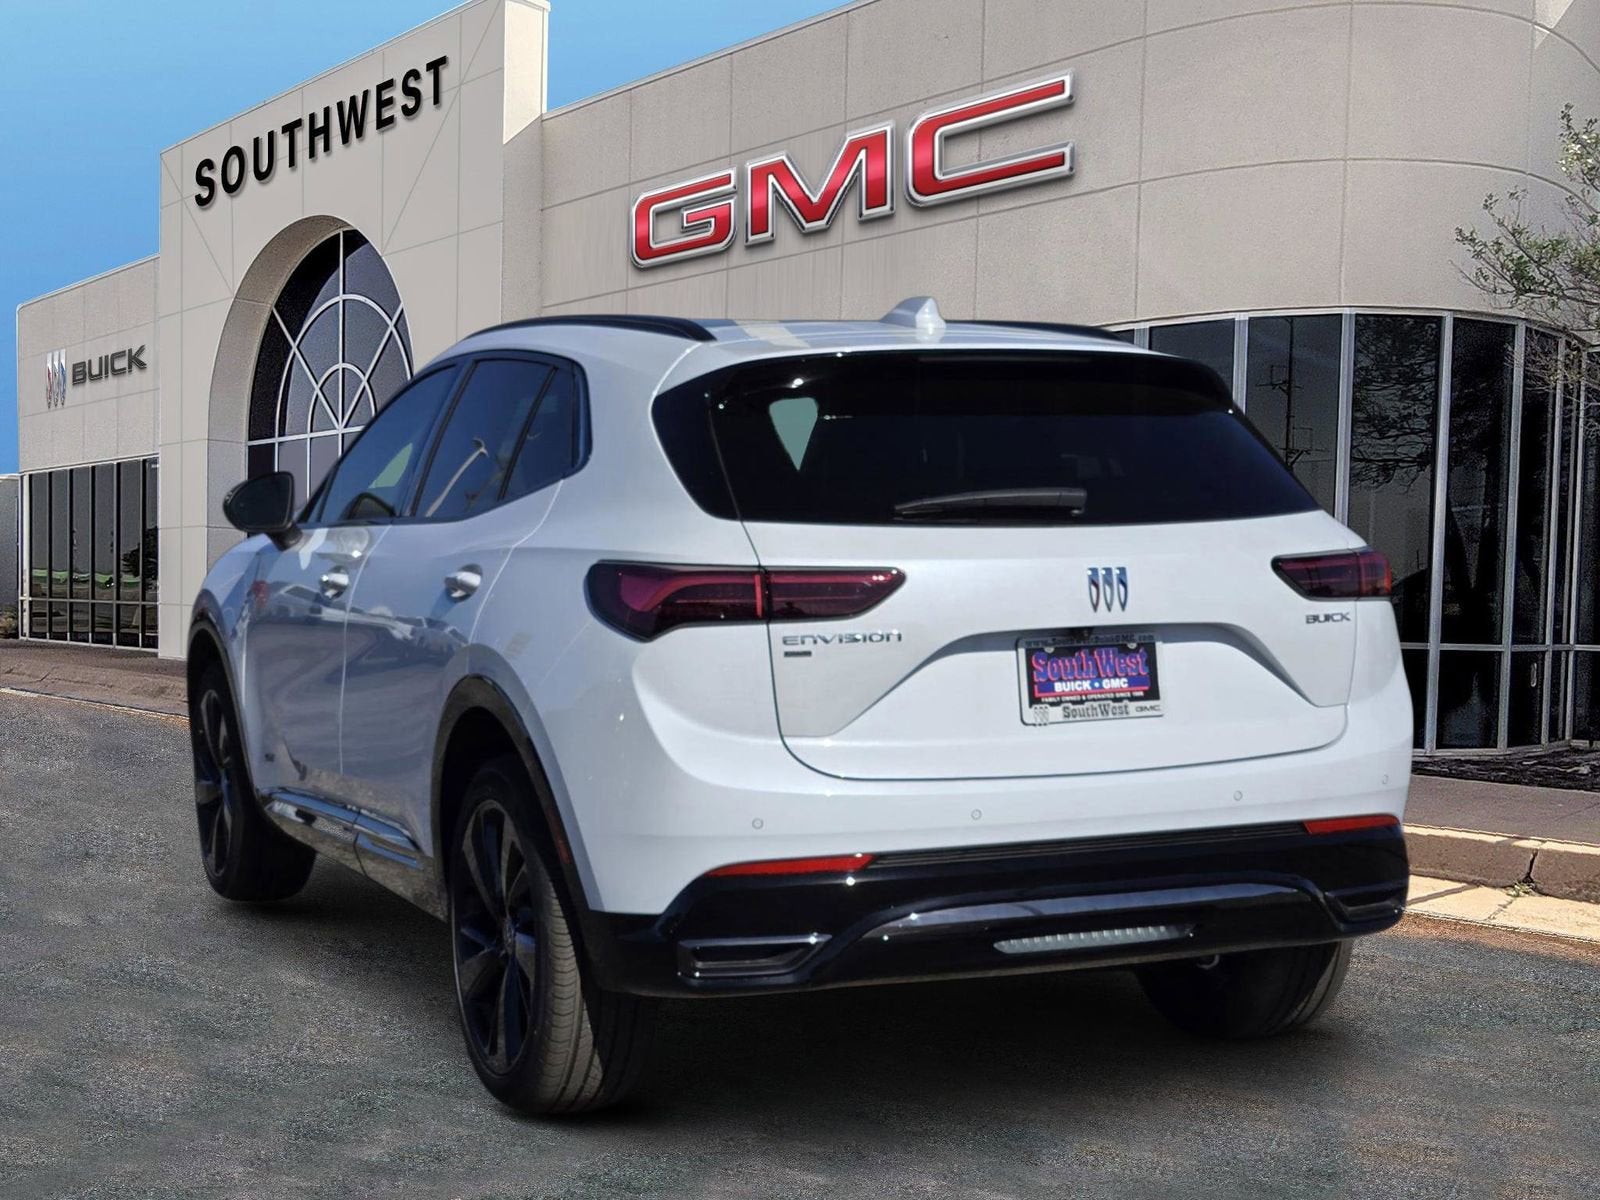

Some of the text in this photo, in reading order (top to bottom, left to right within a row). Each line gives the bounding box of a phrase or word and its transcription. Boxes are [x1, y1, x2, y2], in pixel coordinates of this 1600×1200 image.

[194, 56, 448, 207] SOUTHWEST
[631, 69, 1075, 268] GMC
[72, 344, 147, 386] BUICK
[1305, 612, 1351, 624] BUICK
[782, 631, 902, 645] ENVISION
[1031, 647, 1149, 682] SouthWest
[1054, 678, 1129, 692] BUICK GMC
[1062, 703, 1161, 719] SouthWest GMC
